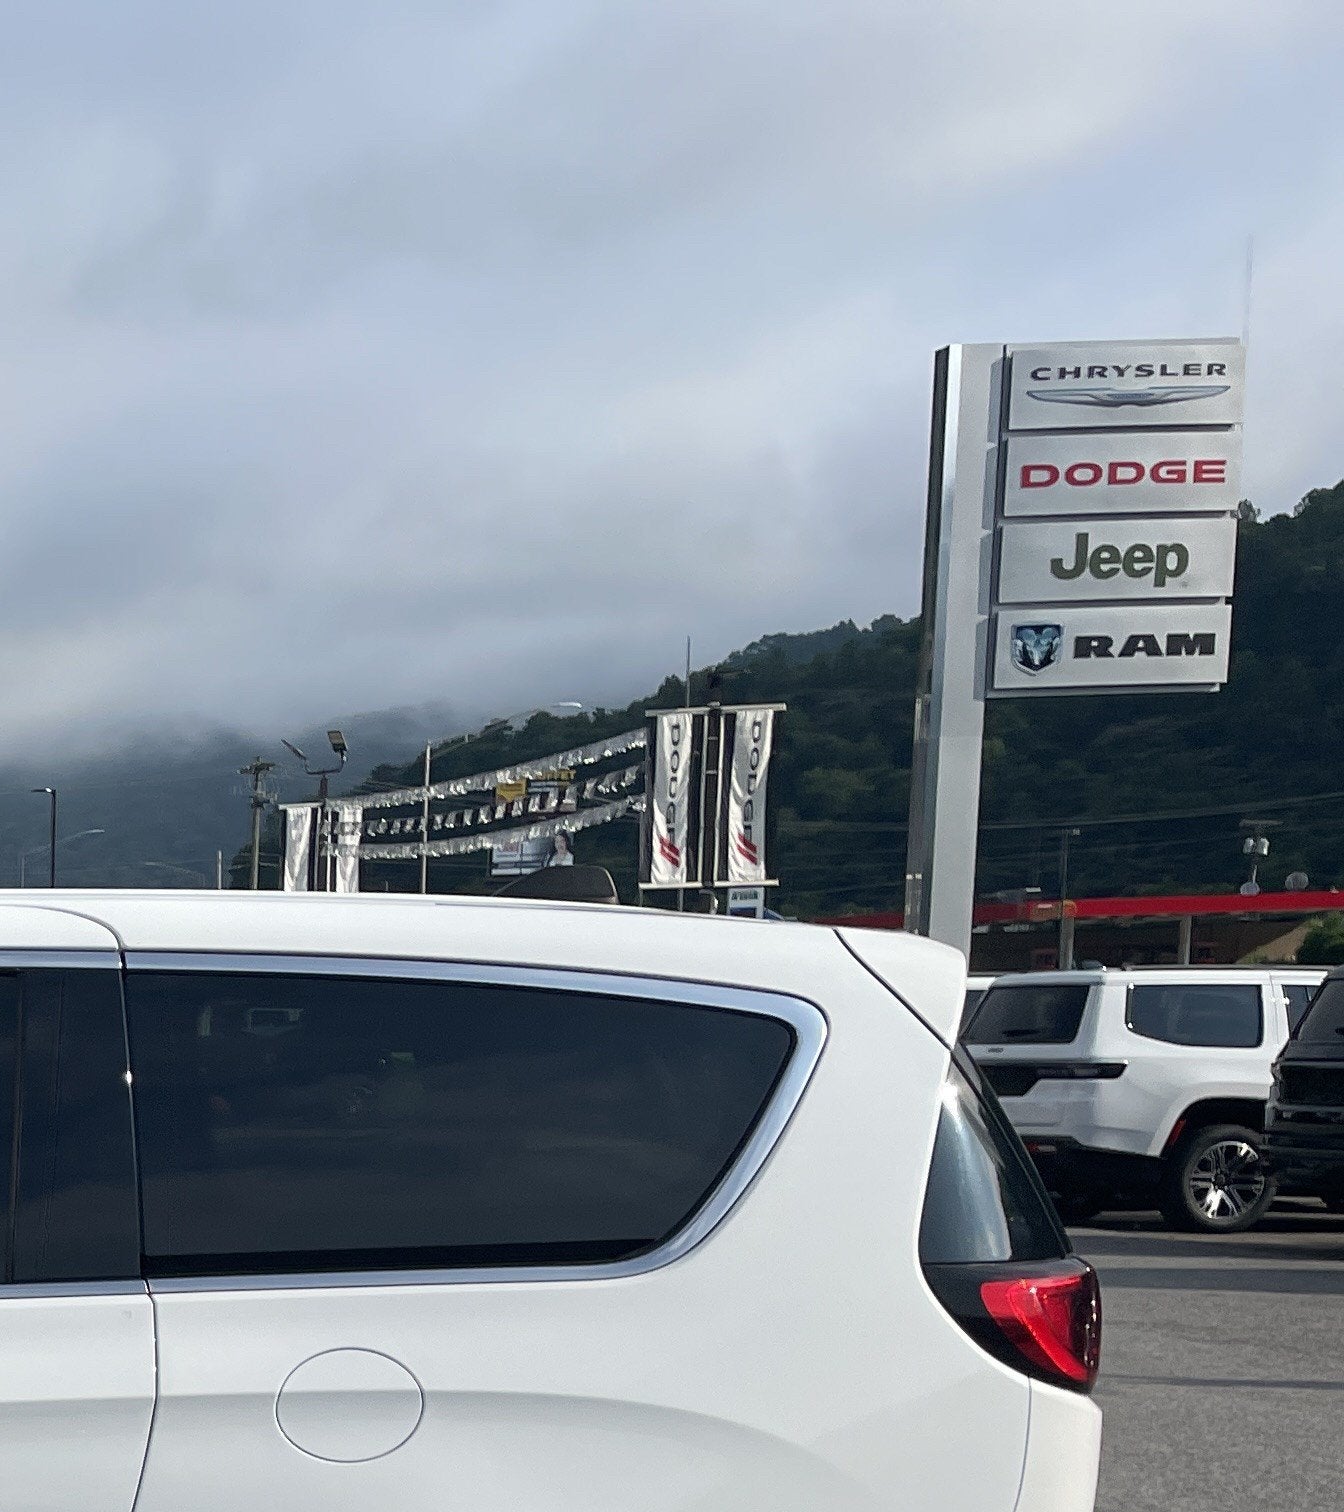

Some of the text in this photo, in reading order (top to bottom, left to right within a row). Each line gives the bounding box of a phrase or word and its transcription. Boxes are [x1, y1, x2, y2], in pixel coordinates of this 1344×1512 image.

[1029, 362, 1227, 382] CHRYSLER
[1020, 459, 1227, 489] DODGE
[1050, 533, 1189, 587] Jeep
[1072, 633, 1216, 659] RAM
